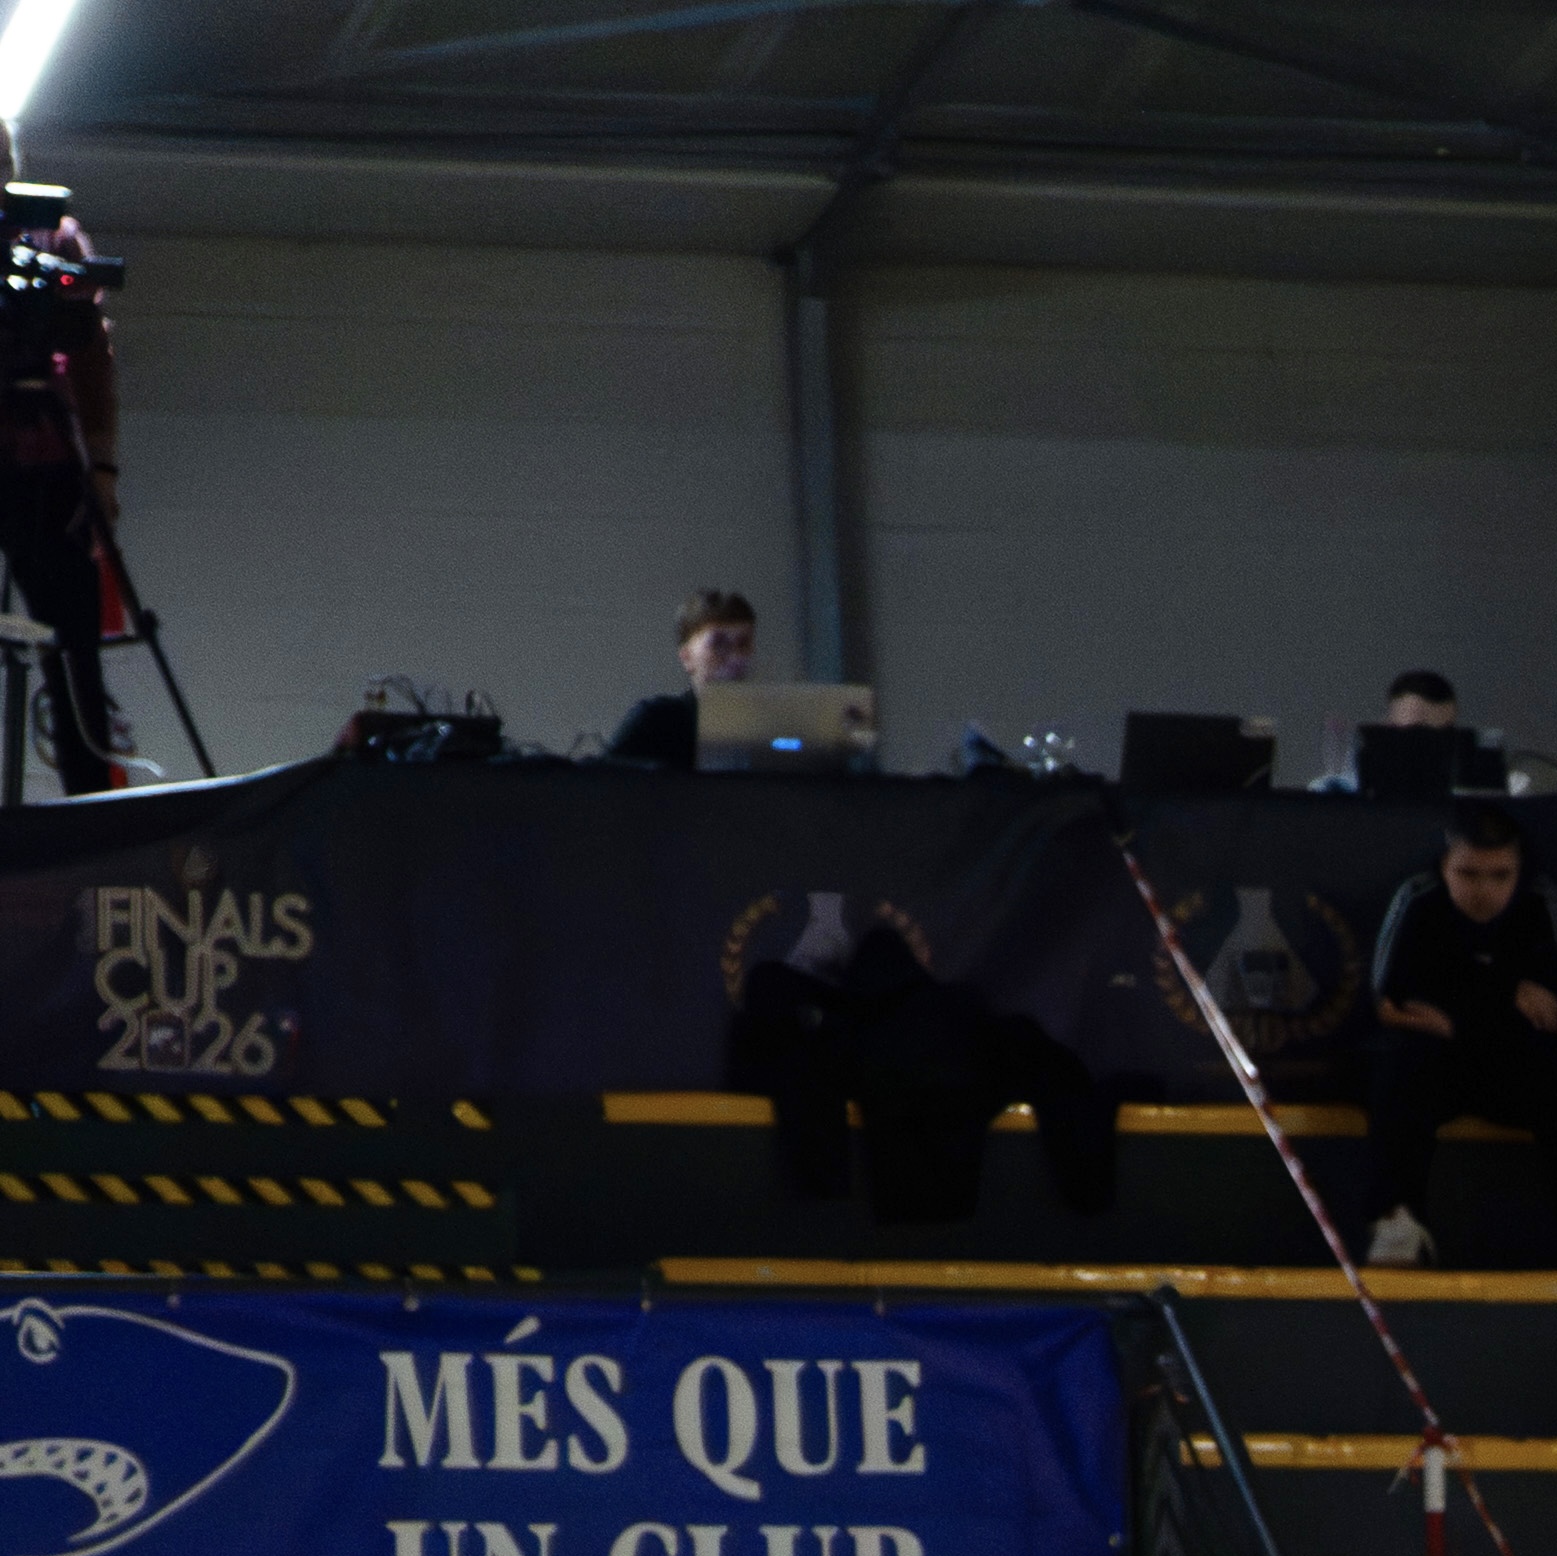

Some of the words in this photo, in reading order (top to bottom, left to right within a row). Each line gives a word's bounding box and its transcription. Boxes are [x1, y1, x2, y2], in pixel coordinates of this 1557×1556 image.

[96, 885, 314, 960] FINALS
[94, 946, 239, 1014] CUP
[377, 1315, 630, 1475] MÉS
[671, 1353, 927, 1501] QUE
